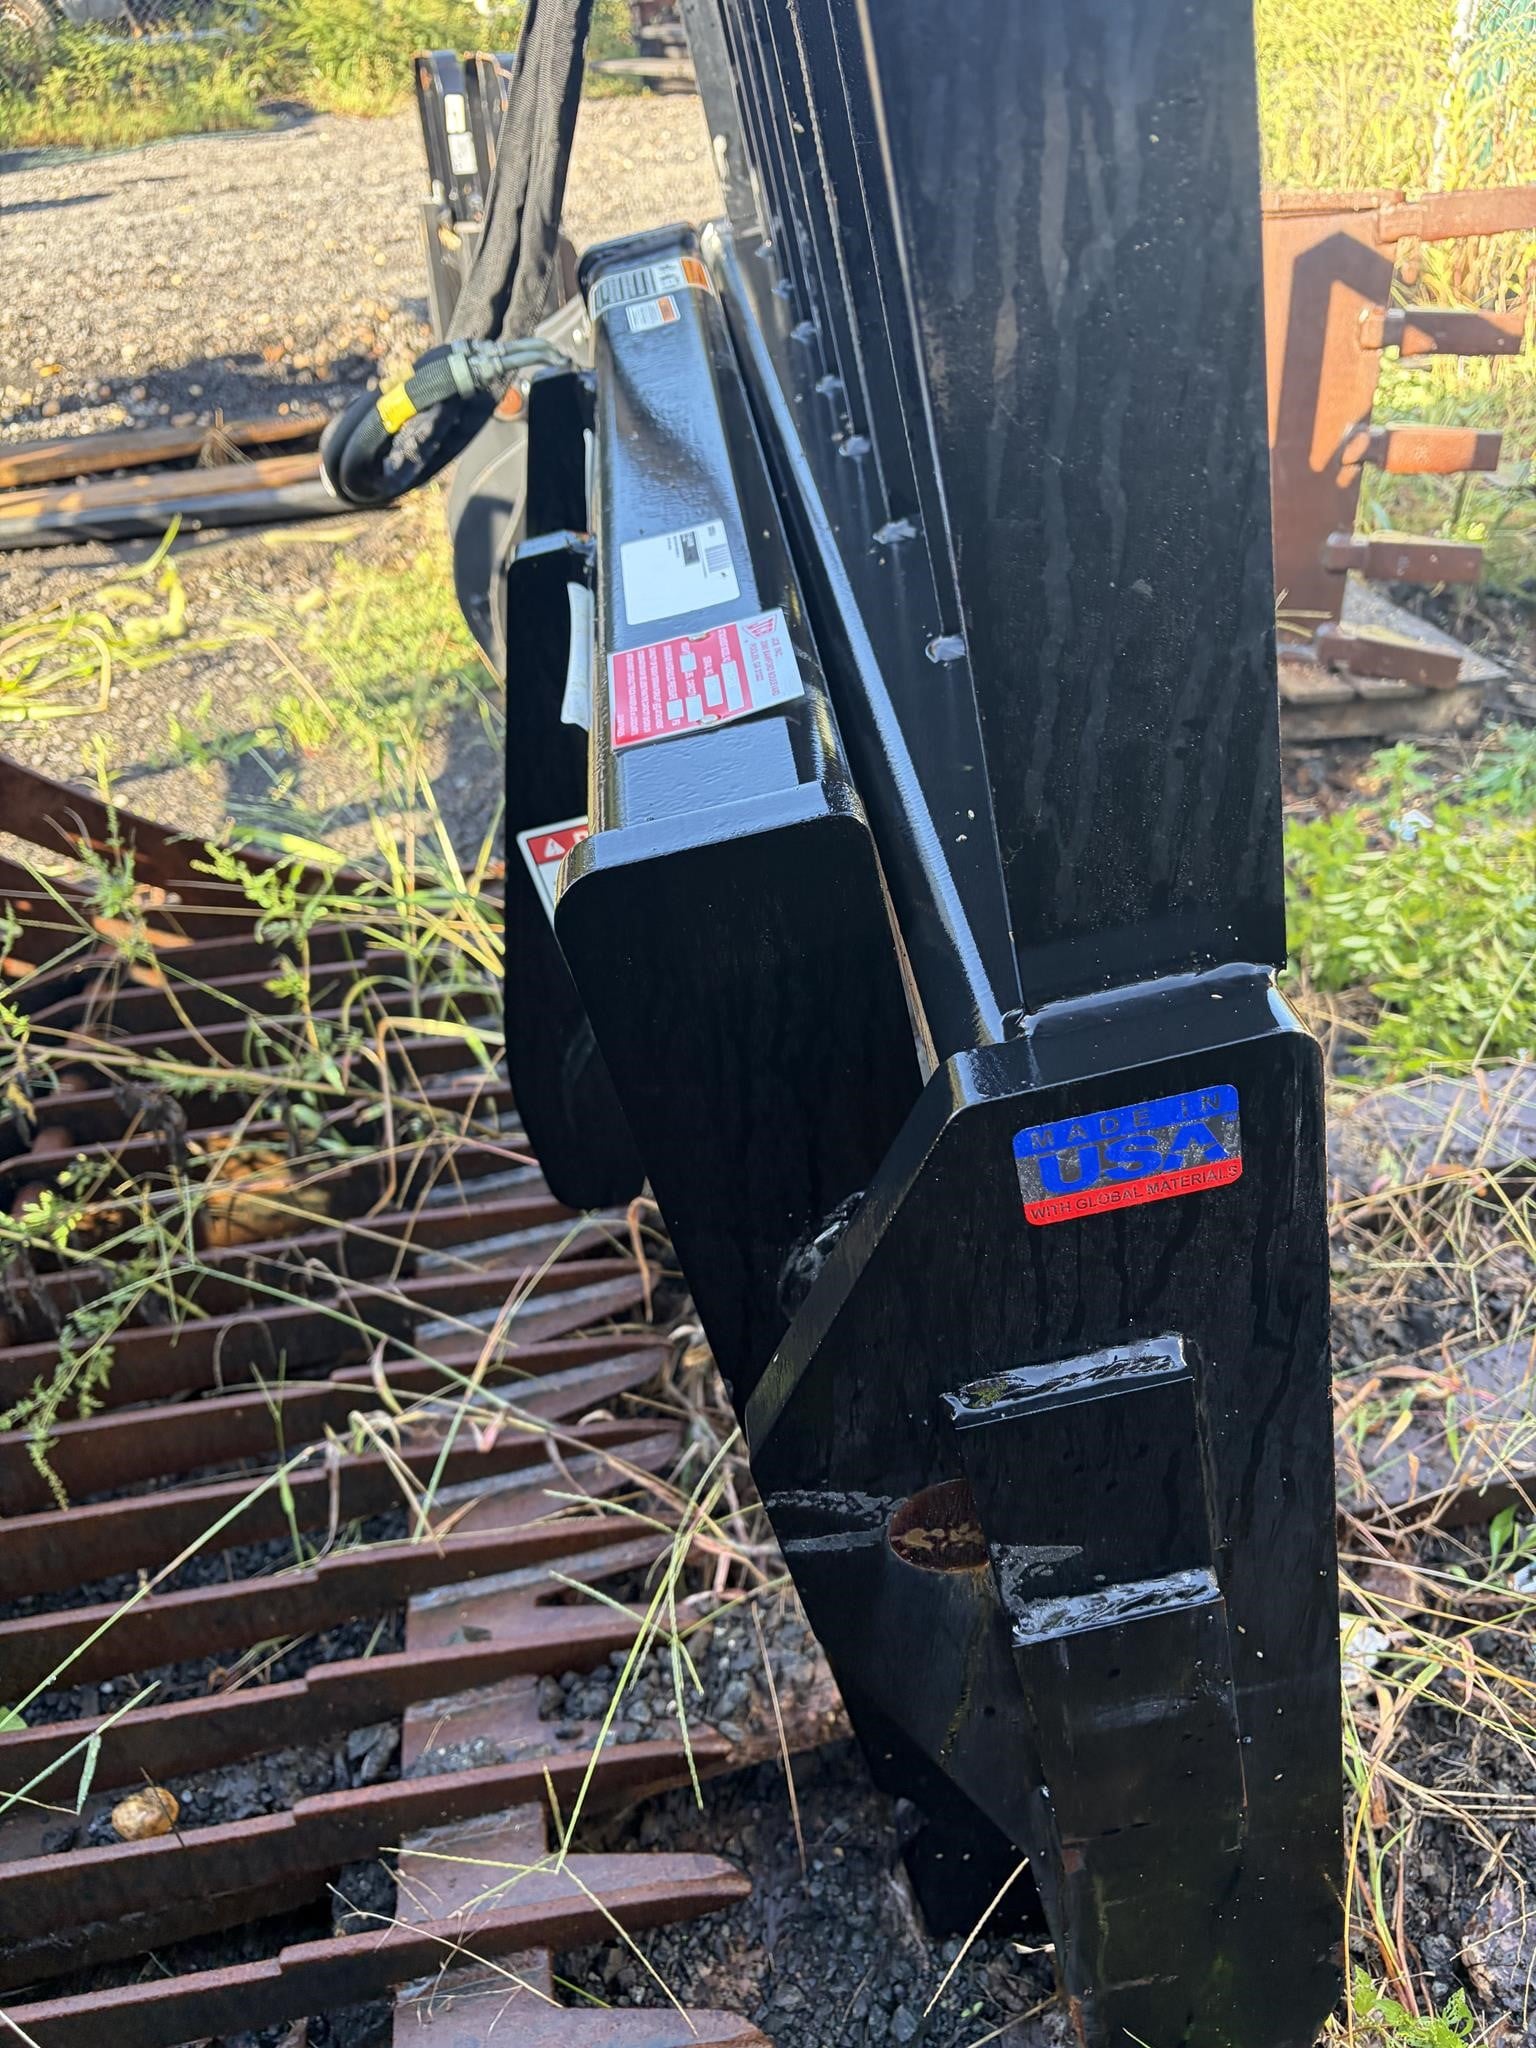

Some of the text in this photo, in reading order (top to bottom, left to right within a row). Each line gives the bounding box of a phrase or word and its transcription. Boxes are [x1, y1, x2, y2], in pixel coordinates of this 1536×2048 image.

[1031, 1092, 1220, 1150] MADE IN
[1037, 1121, 1228, 1194] USA
[1030, 1165, 1238, 1220] WITH GLOBAL MATERIALS
